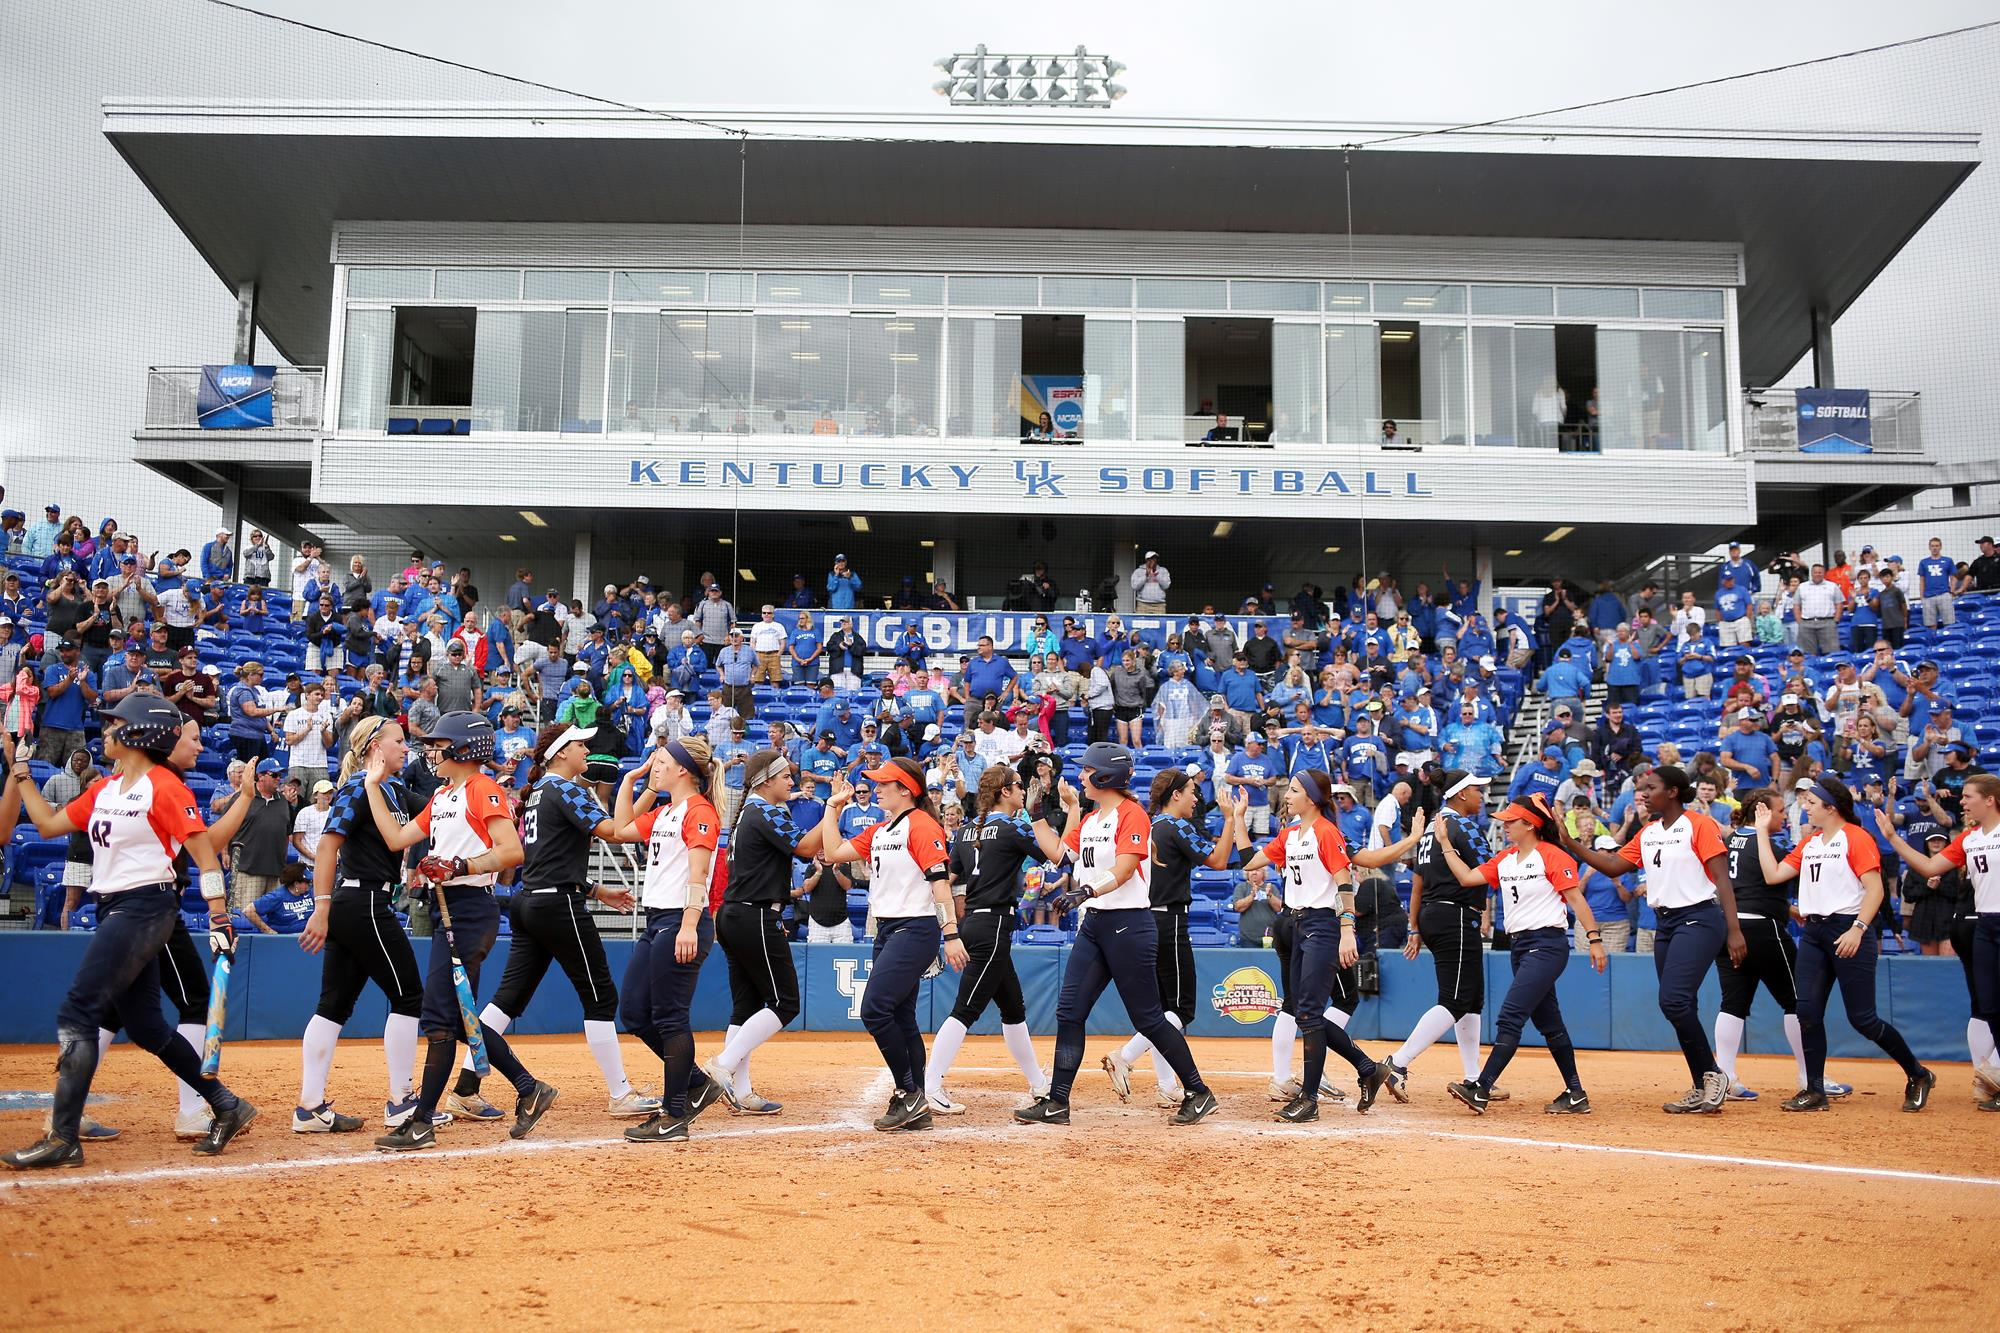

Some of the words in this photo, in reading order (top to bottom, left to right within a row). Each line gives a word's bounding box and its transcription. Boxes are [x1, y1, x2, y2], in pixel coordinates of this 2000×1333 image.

[220, 377, 252, 387] NCAA
[1053, 390, 1082, 398] ESPN
[1057, 414, 1082, 422] NCAA
[1816, 406, 1867, 418] SOFTBALL
[628, 460, 984, 490] KENTUCKY
[1011, 459, 1067, 497] UK
[1098, 467, 1433, 496] SOFTBALL
[1533, 772, 1560, 786] KENTUCKY
[853, 816, 876, 827] KENTUCKY
[92, 820, 111, 848] 42
[1082, 846, 1095, 868] 00
[1418, 835, 1433, 865] 22
[1653, 849, 1661, 868] 4
[972, 848, 980, 875] 1
[1729, 851, 1738, 878] 3
[1973, 855, 1988, 873] 13
[1810, 863, 1822, 883] 17
[283, 898, 314, 910] WILDCATS
[1511, 886, 1518, 904] 3
[1214, 998, 1249, 1008] WORLD
[1250, 998, 1282, 1008] SERIES
[1228, 991, 1271, 999] COLLEGE
